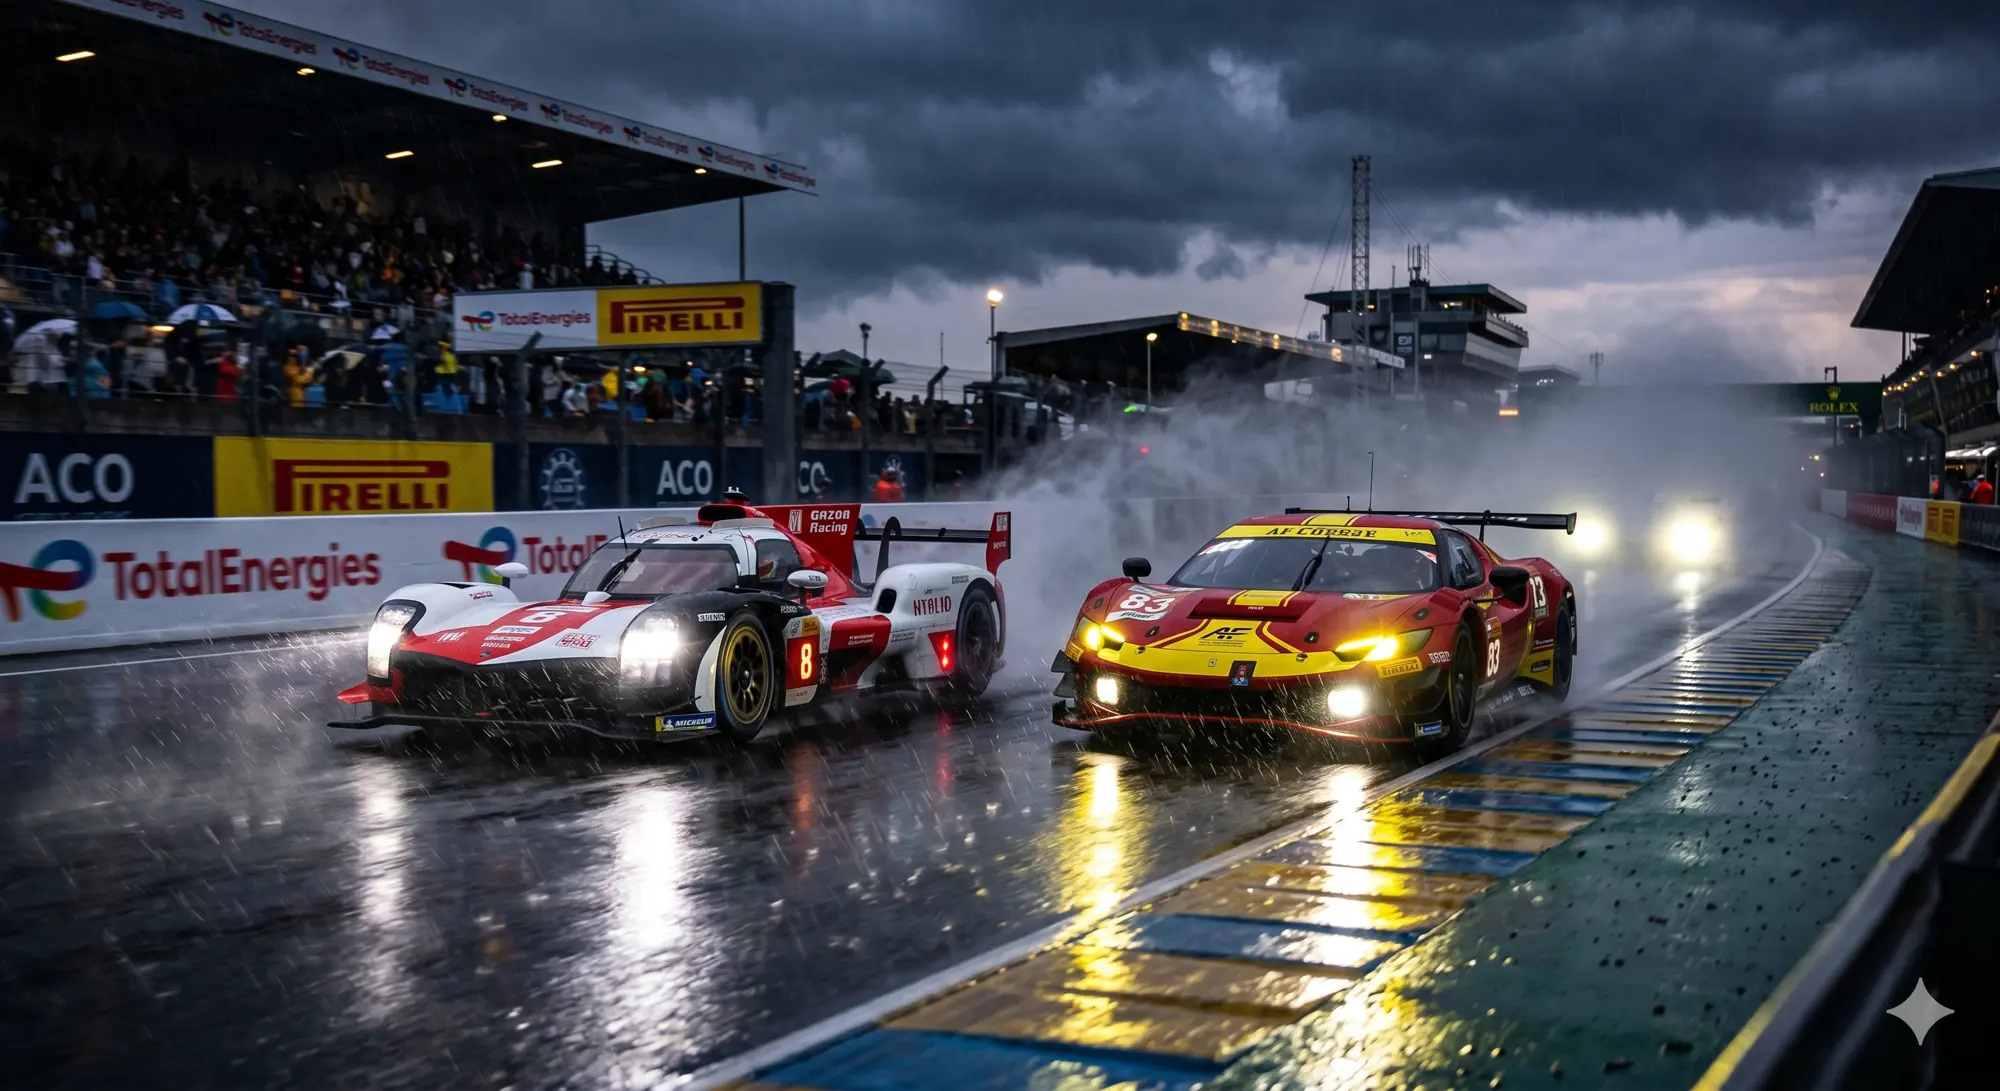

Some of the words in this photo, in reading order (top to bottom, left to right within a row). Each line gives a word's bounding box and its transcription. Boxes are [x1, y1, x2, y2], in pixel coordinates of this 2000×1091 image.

[237, 20, 317, 55] TotalEnergies
[362, 55, 430, 85] TotalEnergies
[497, 310, 591, 327] TotalEnergies
[610, 297, 745, 334] PIRELLI
[1809, 402, 1859, 412] ROLEX
[15, 453, 134, 503] ACO
[273, 459, 450, 513] PIRELLI
[656, 460, 713, 495] ACO
[809, 521, 848, 536] Racing
[103, 543, 381, 601] TotalEnergies
[1119, 593, 1176, 613] 83
[800, 643, 812, 680] 8
[1487, 638, 1501, 678] 83
